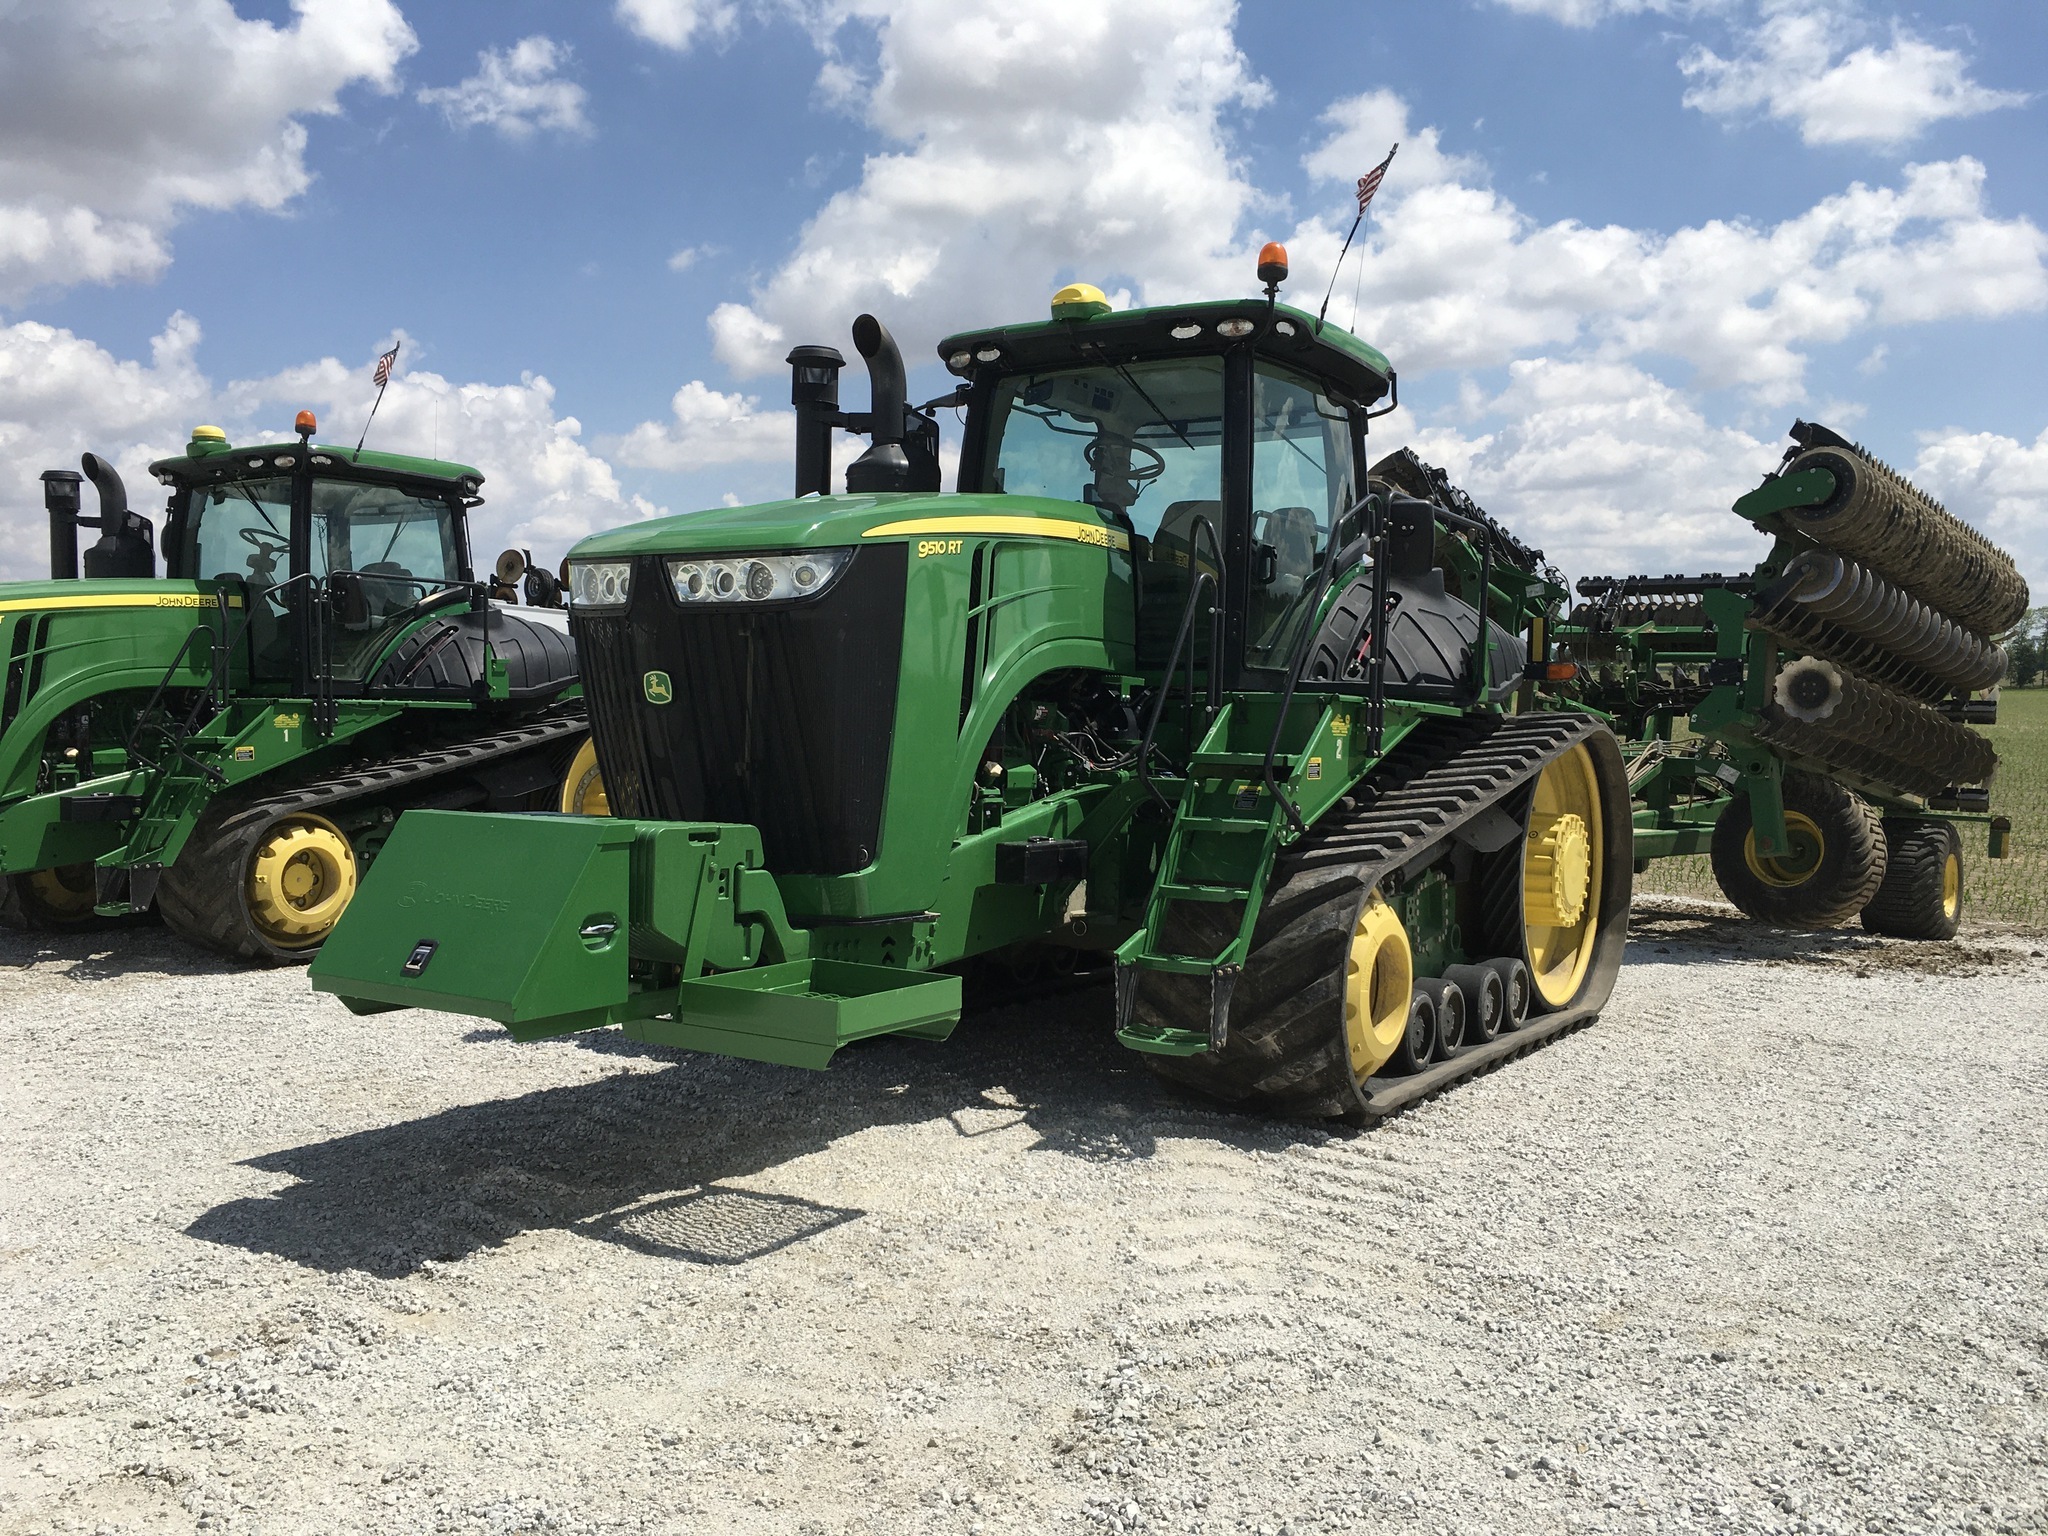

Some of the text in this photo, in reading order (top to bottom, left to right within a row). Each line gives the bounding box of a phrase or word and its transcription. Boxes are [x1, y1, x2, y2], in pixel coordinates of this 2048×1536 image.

[1078, 525, 1116, 547] JOHN DEERE
[918, 540, 963, 558] 9510 RT
[156, 596, 218, 607] JOHN DEERE
[283, 728, 289, 742] 1
[1336, 738, 1343, 759] 2
